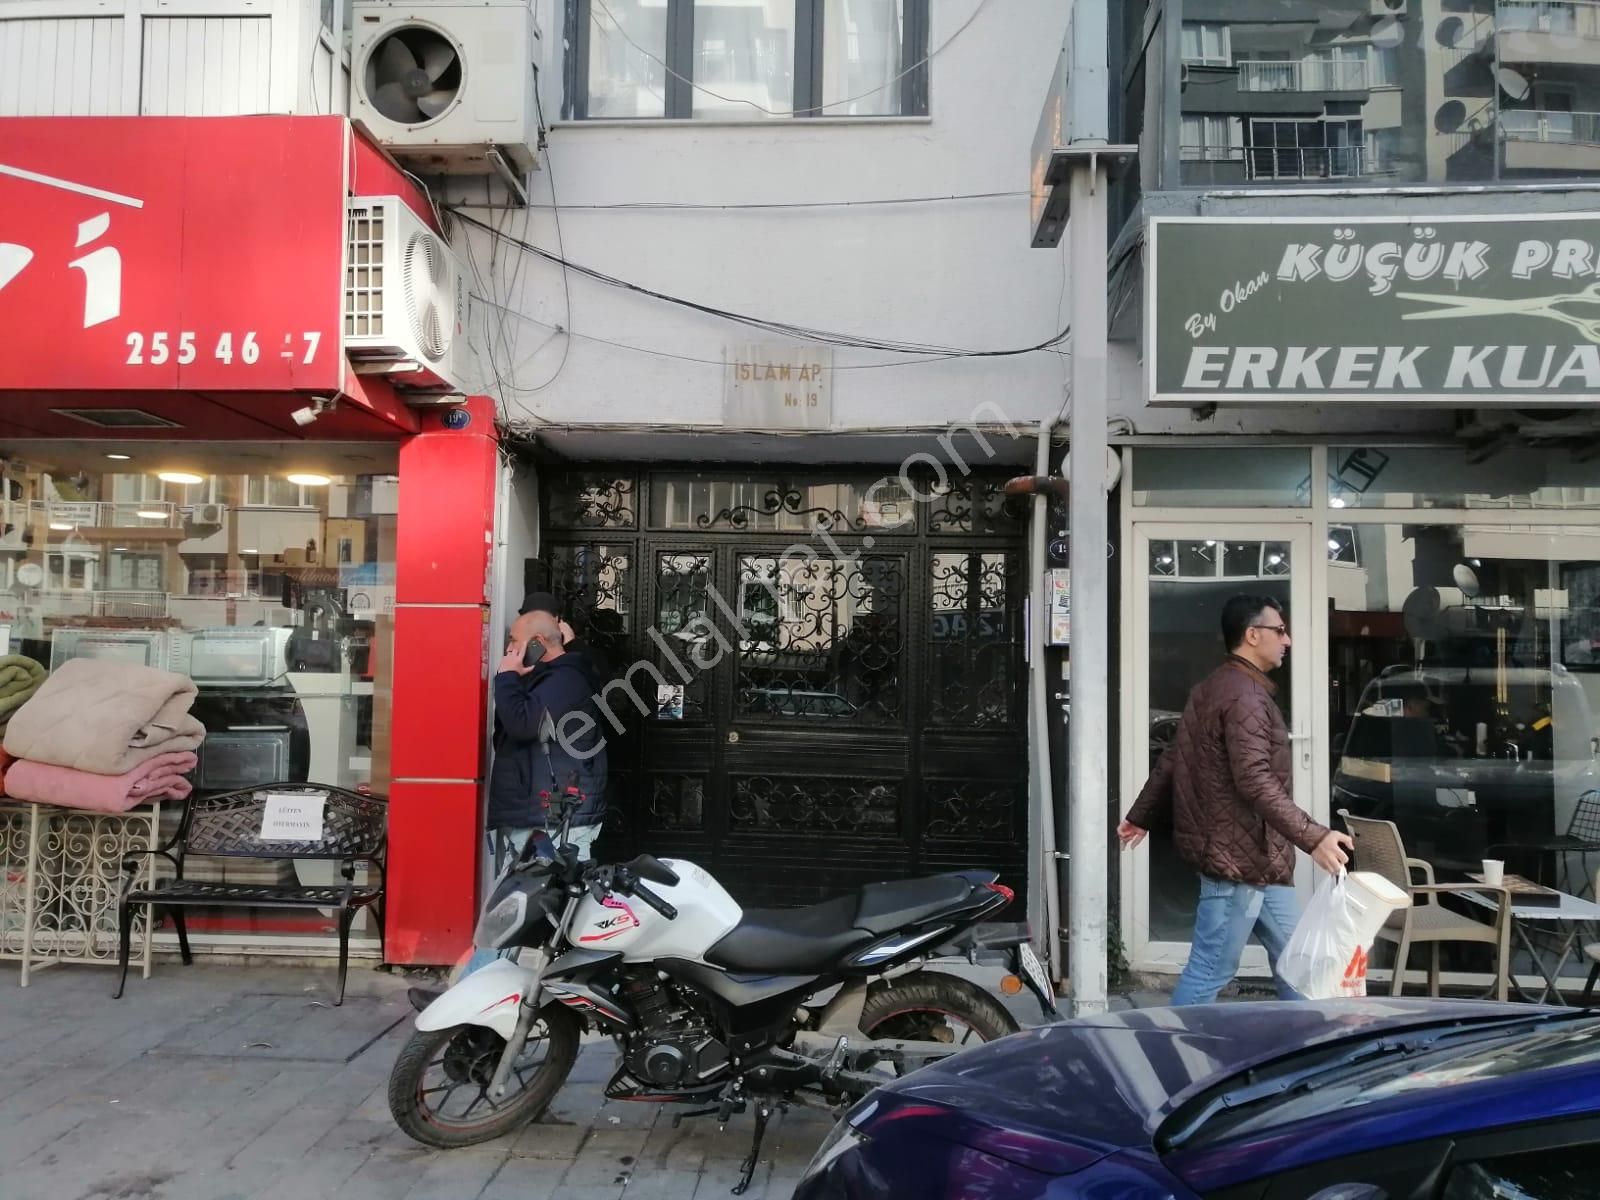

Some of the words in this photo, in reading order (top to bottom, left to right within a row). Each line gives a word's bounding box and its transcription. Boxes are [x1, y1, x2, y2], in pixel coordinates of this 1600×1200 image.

[1277, 227, 1491, 296] KÜÇÜK
[1511, 238, 1600, 281] PR
[1184, 312, 1217, 339] By
[1220, 271, 1270, 313] Okan
[125, 331, 197, 366] 255
[215, 331, 260, 366] 46
[1182, 346, 1429, 389] ERKEK
